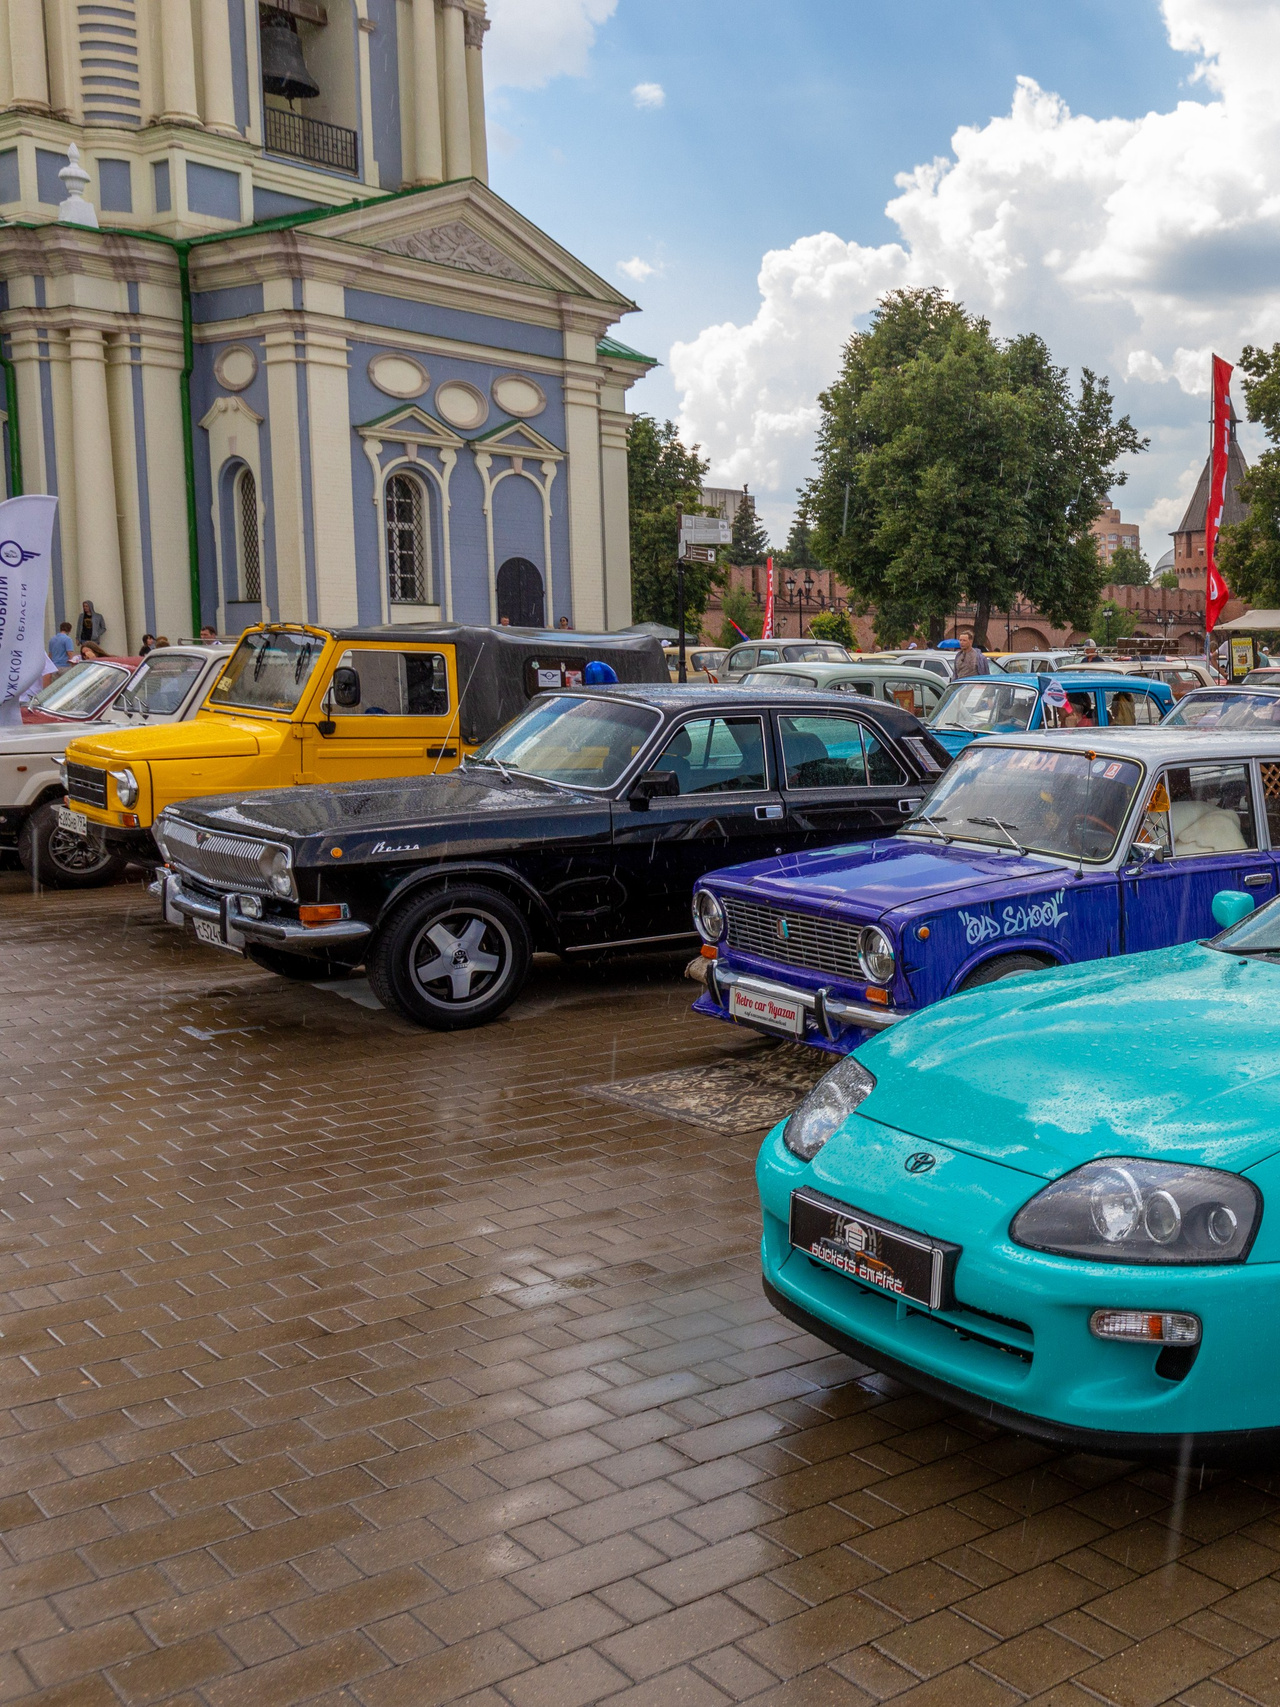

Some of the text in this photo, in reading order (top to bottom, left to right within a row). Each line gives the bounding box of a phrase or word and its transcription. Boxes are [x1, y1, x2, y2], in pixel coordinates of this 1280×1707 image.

[16, 583, 27, 642] ОБЛАСТИ
[1006, 751, 1060, 772] LADA
[735, 991, 753, 1009] Retro
[754, 1000, 767, 1012] car
[767, 1000, 796, 1021] Ryazan
